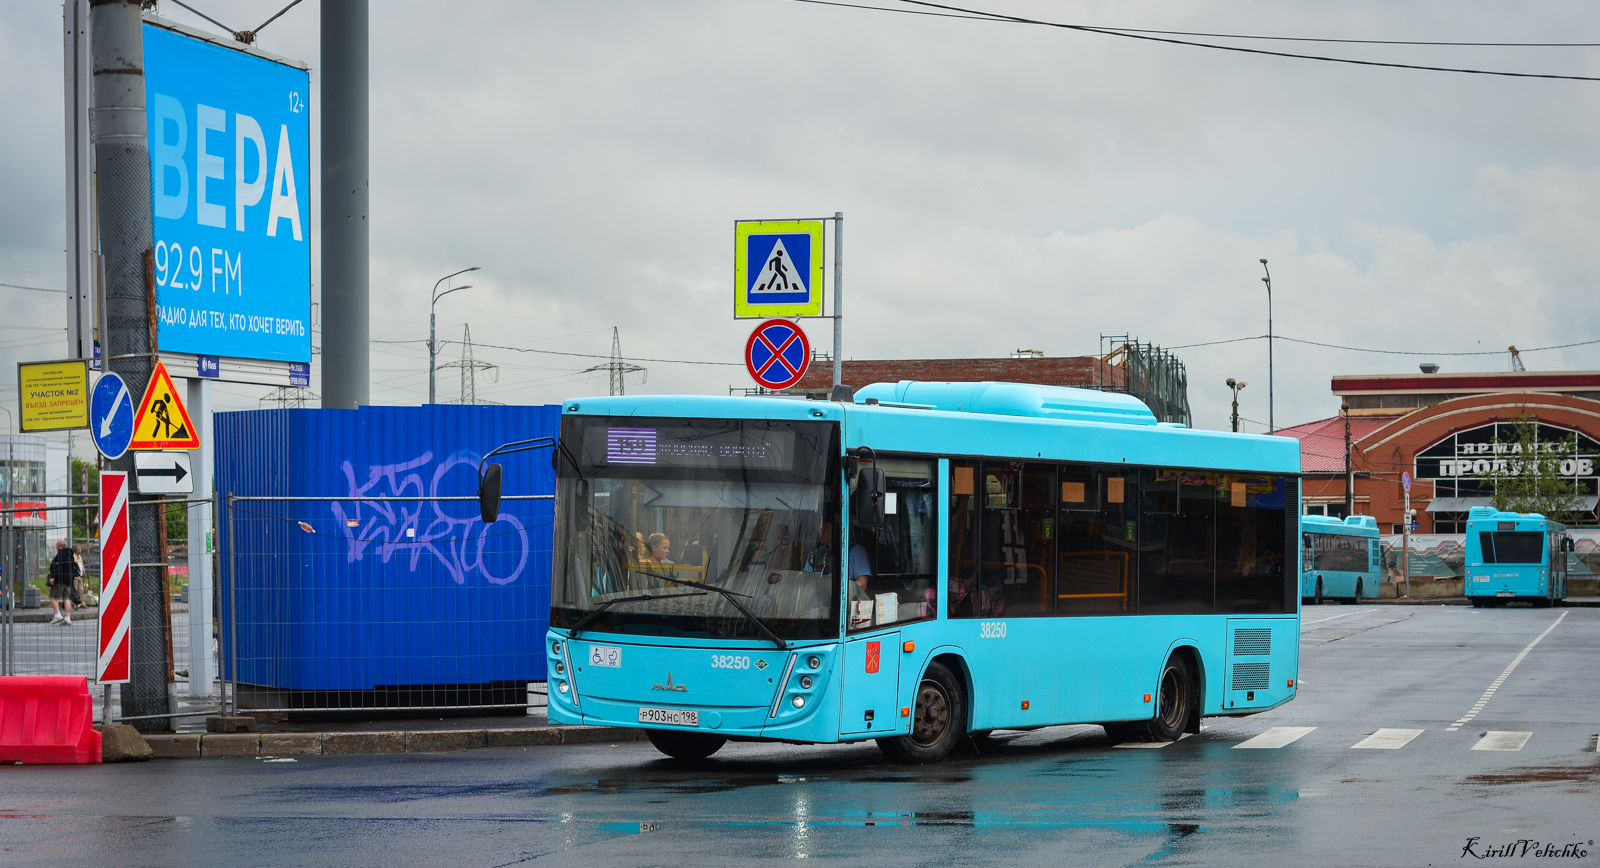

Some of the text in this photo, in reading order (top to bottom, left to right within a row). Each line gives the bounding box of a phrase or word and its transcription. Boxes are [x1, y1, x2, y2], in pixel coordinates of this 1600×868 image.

[288, 91, 304, 113] 12+
[154, 92, 303, 241] ВЕРА
[155, 240, 242, 296] 92.9 FM
[155, 304, 305, 337] РАДИО ДЛЯ ТЕХ, КТО ХОЧЕТ ВЕРИТЬ
[30, 388, 79, 399] УЧАСТОК №2
[25, 401, 47, 409] ВЪЕЗД
[1439, 459, 1594, 477] ПРОДУКОВ
[980, 621, 1007, 639] 38250
[711, 655, 750, 669] 38250
[642, 709, 696, 723] Р903НС 198
